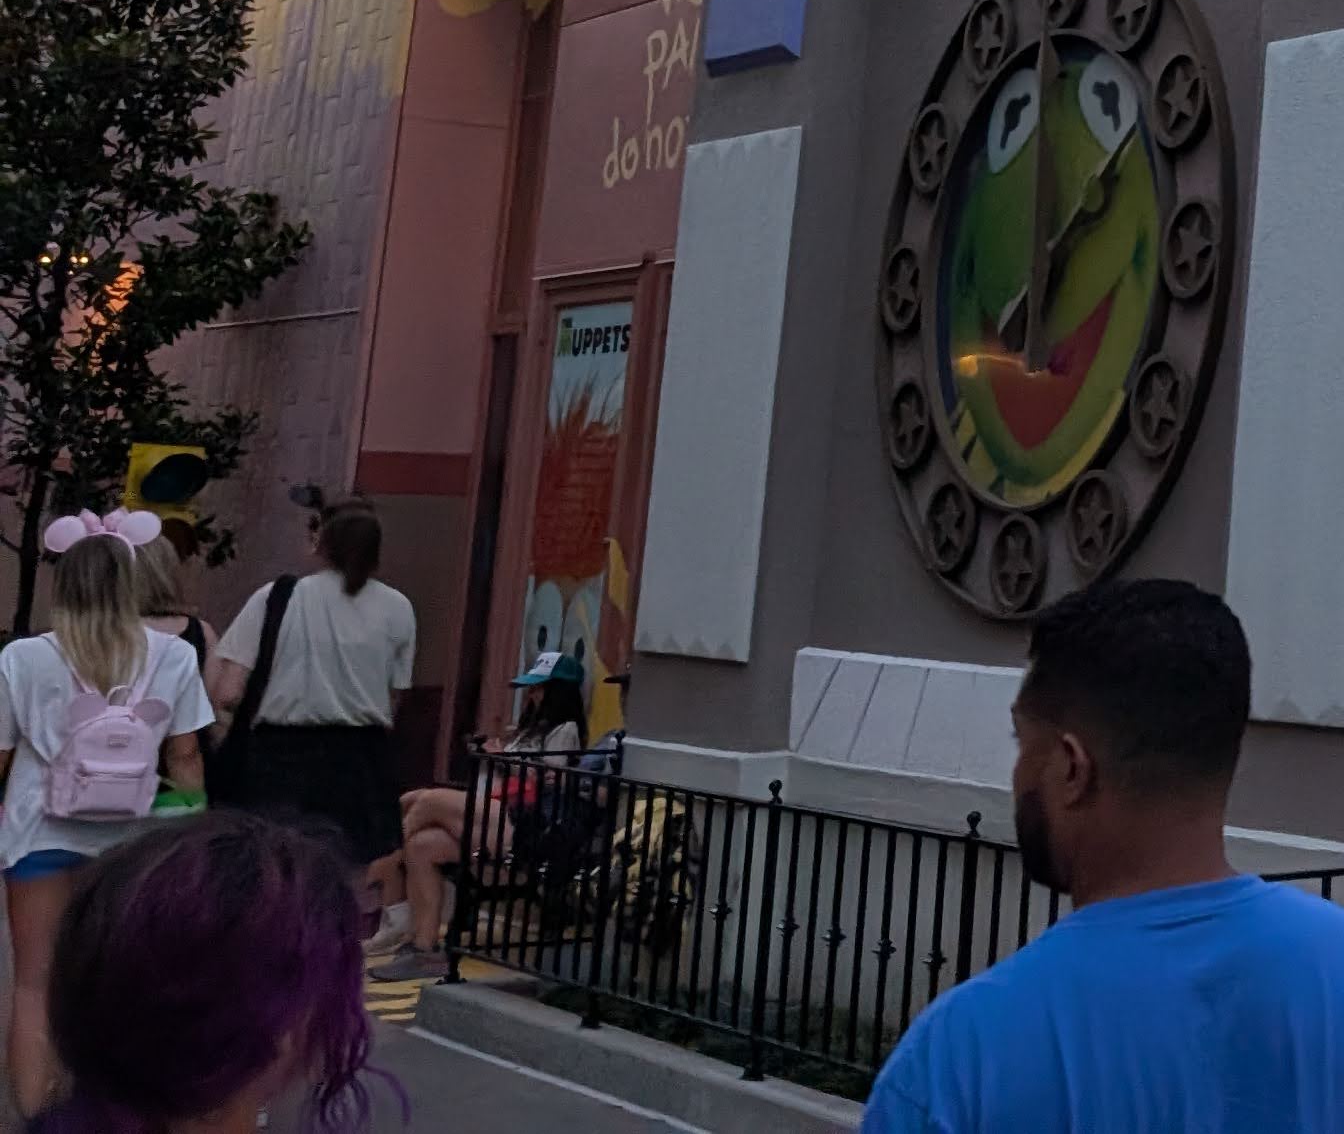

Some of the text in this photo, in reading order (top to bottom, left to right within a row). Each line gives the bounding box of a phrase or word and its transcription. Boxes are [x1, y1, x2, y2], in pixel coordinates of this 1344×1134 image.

[643, 17, 700, 92] PAI
[602, 115, 691, 189] do no
